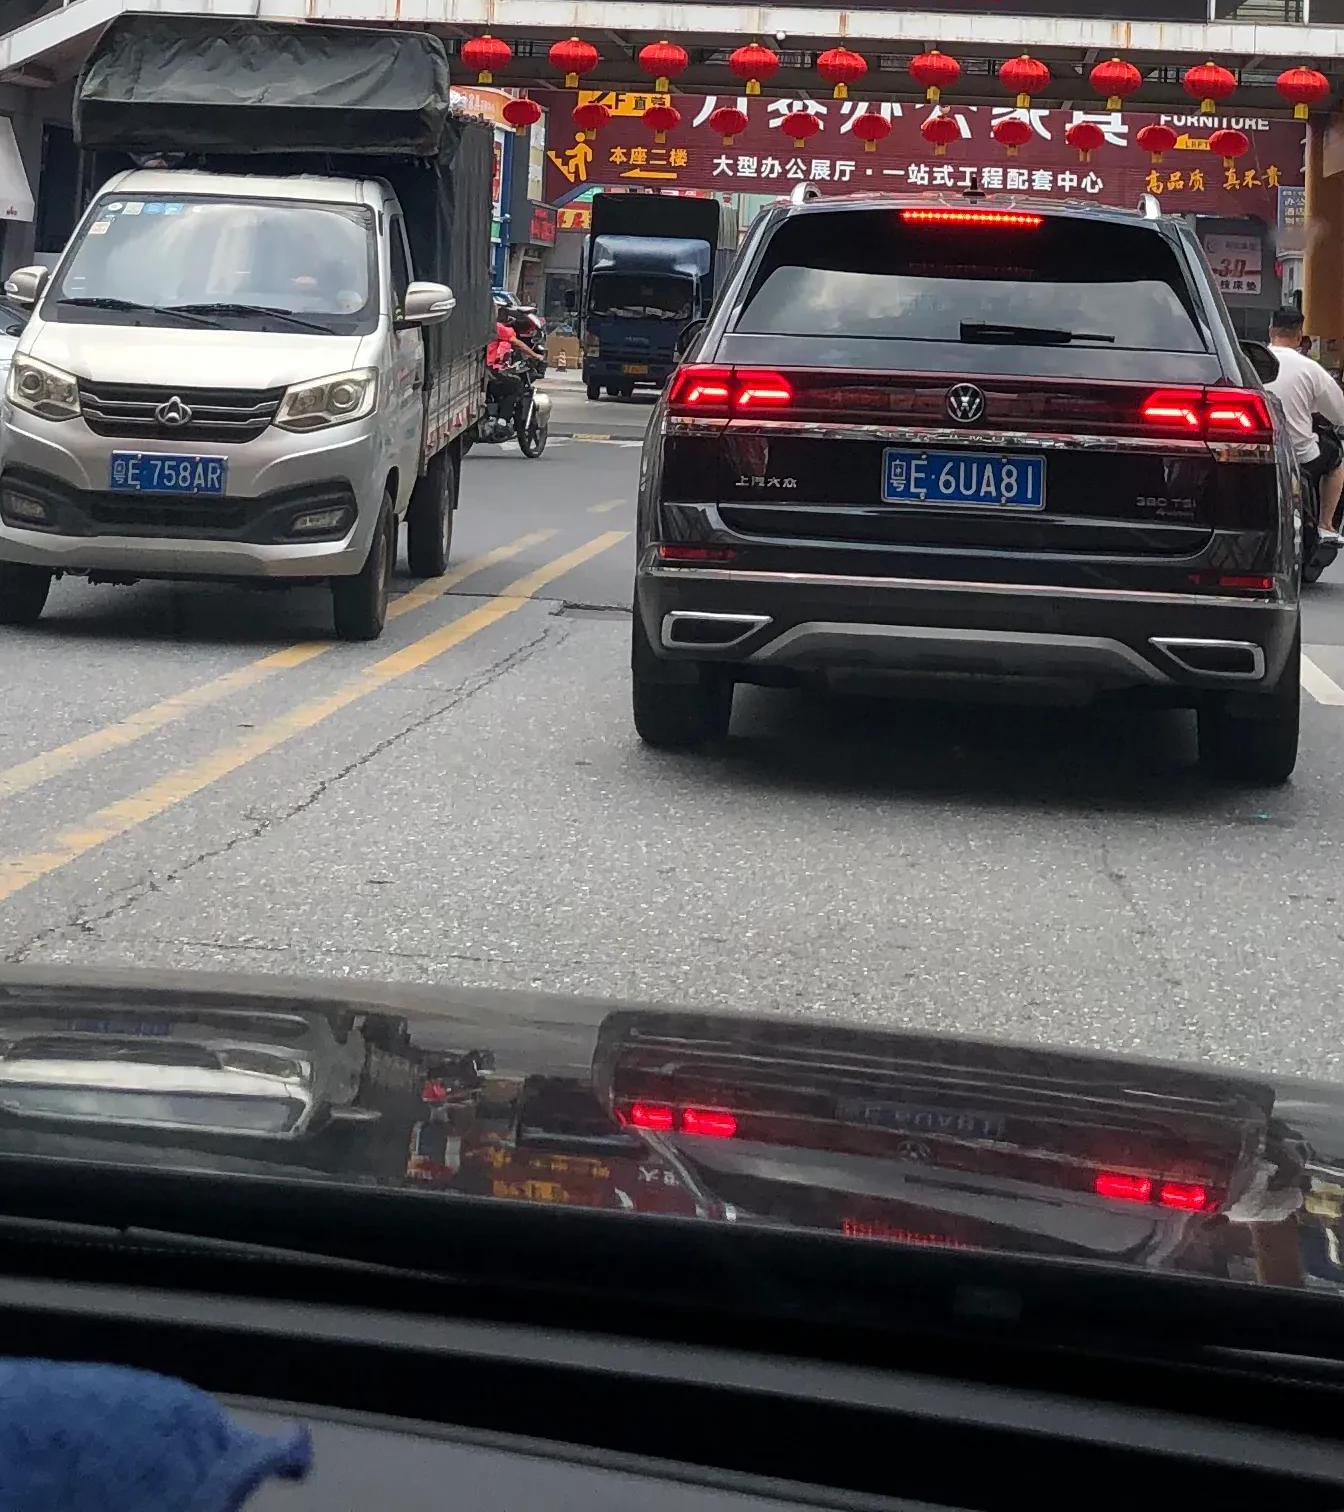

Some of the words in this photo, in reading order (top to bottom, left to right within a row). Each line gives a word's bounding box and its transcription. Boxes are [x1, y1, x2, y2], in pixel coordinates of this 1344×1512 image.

[1160, 114, 1269, 130] FURNITURE
[609, 146, 689, 167] 本座二楼
[1145, 169, 1205, 194] 高品质
[890, 458, 1033, 499] 粤E·6UA81
